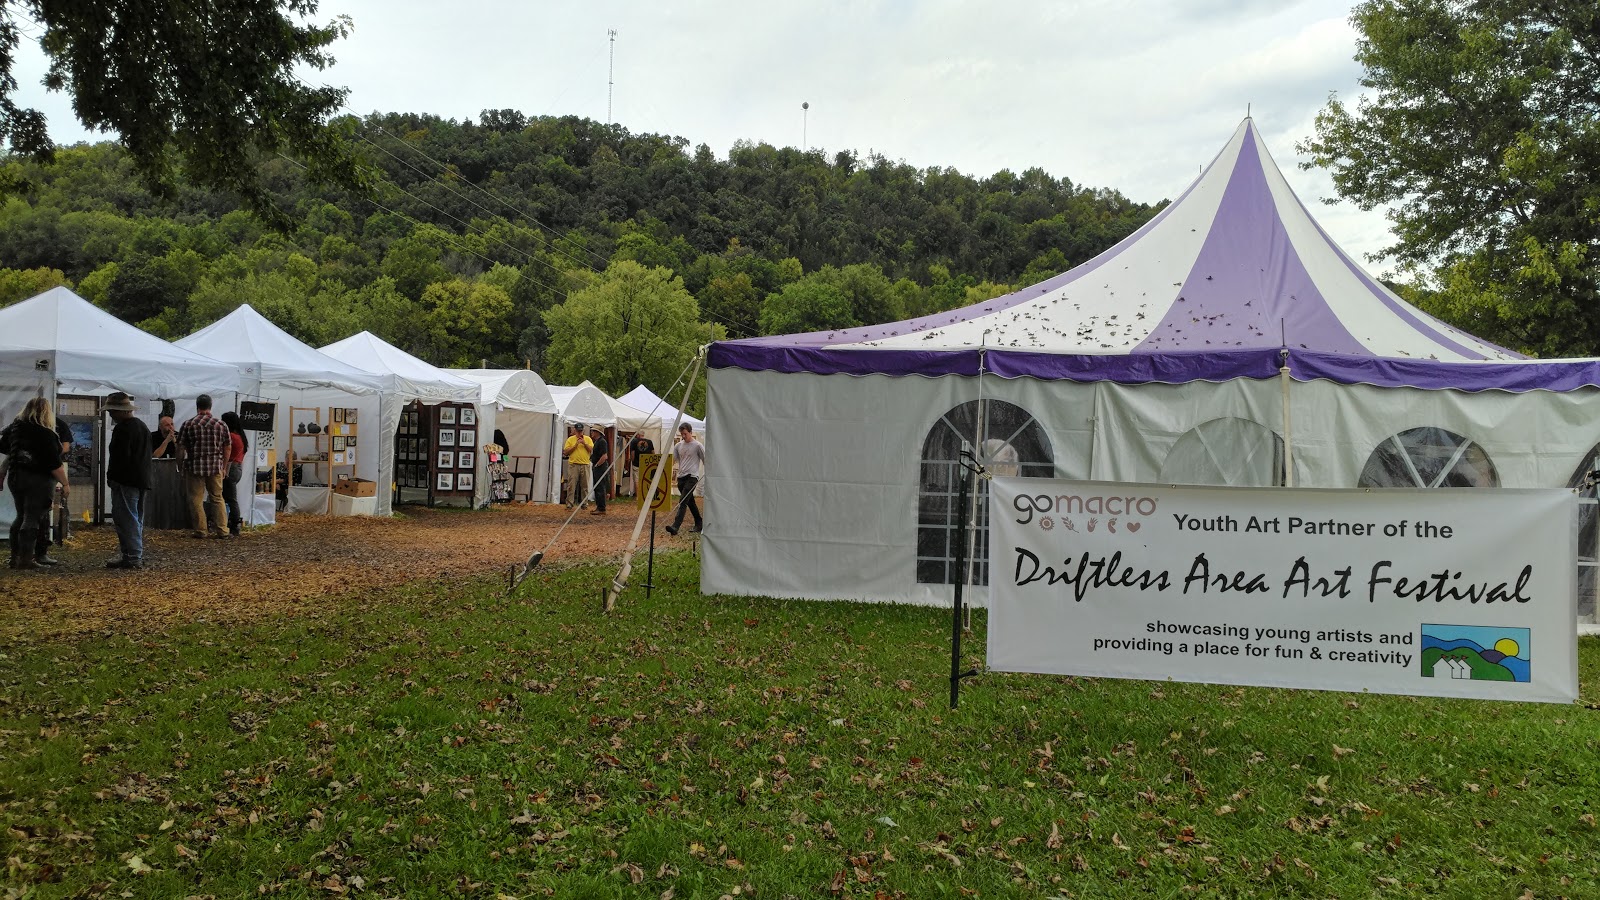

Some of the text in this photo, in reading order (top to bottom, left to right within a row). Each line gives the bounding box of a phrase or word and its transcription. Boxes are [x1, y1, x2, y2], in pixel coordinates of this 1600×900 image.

[1173, 513, 1454, 539] Youth Art Partner of the
[1014, 546, 1533, 605] Driftless Area Art Festival
[1146, 619, 1413, 646] showcasing young artists and
[1093, 637, 1413, 668] providing a place for fun & creativity
